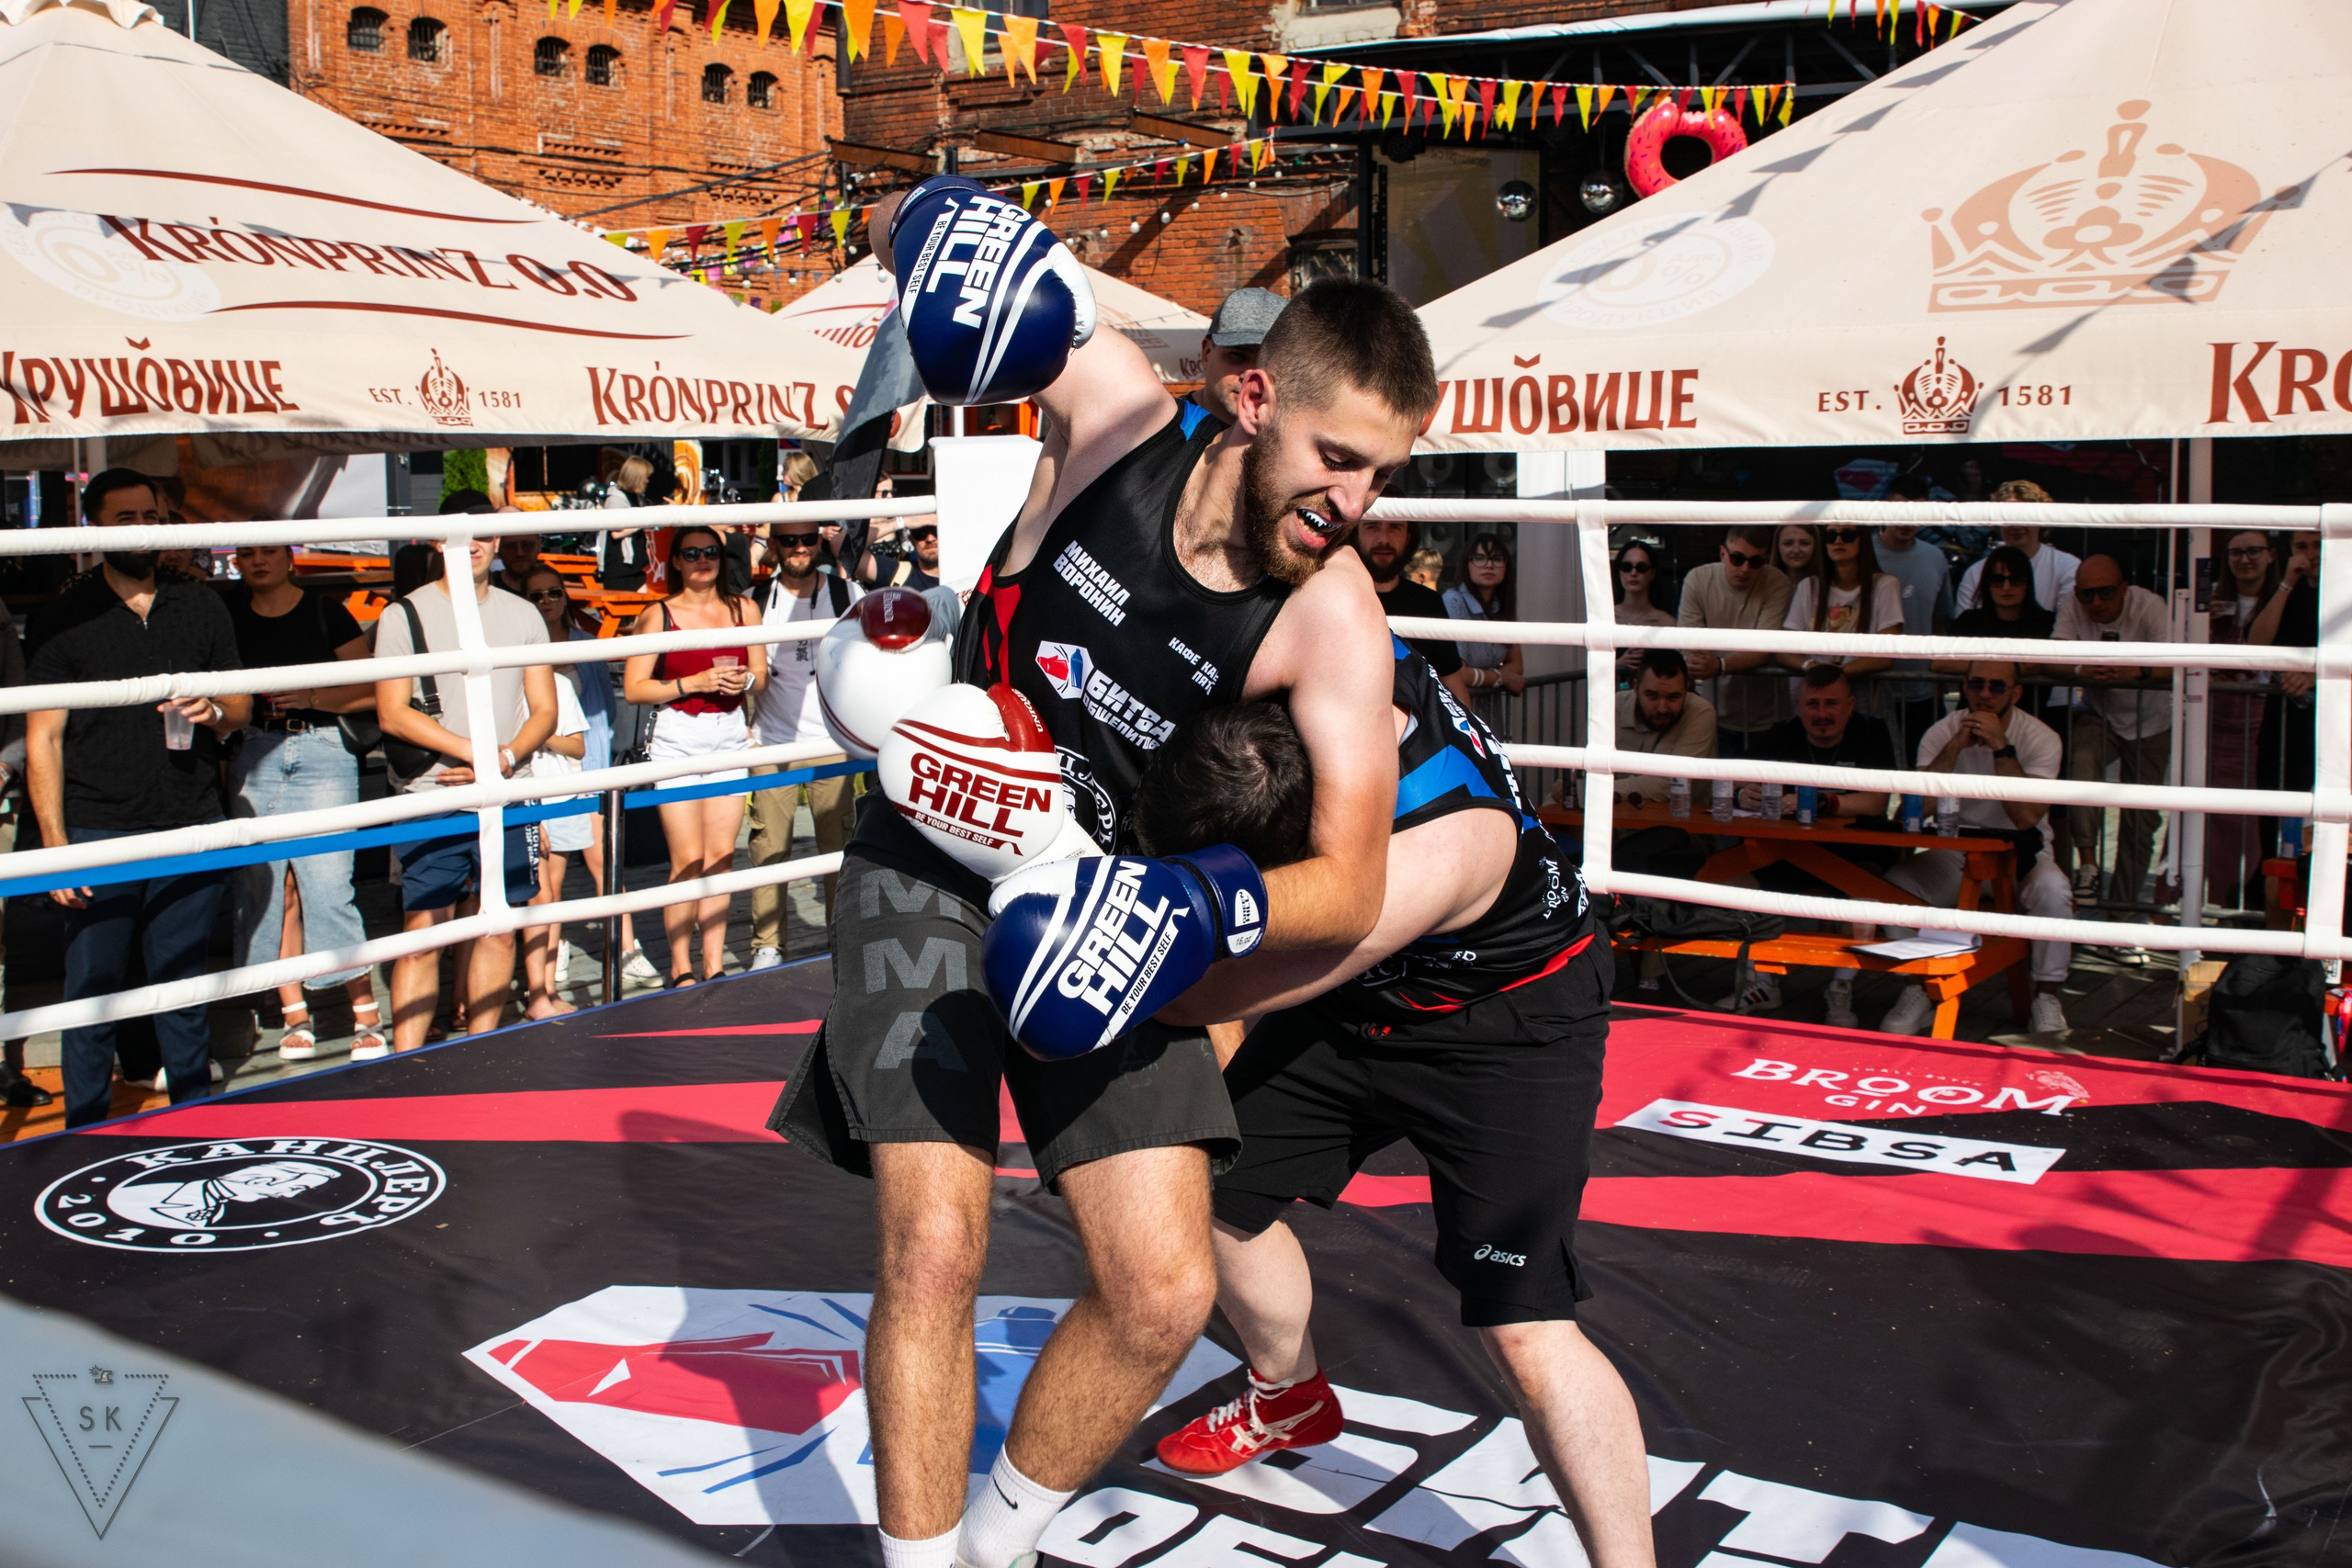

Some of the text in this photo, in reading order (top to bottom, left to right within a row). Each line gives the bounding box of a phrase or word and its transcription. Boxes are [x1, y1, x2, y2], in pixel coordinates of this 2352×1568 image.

[908, 220, 947, 294] BE YOUR BEST SELF
[925, 196, 1007, 293] HILL
[952, 204, 1032, 329] GREEN
[368, 387, 523, 409] EST. 1581
[1817, 384, 2072, 412] EST. 1581
[1053, 553, 1125, 626] ВОРОНИН
[1064, 540, 1130, 606] МИХАИЛ
[1169, 637, 1201, 665] КАФЕ
[1085, 670, 1176, 743] БИТВА
[908, 775, 1024, 838] HILL
[910, 752, 1051, 813] GREEN
[915, 811, 994, 847] BE YOUR BEST SELF
[1057, 861, 1148, 999] GREEN
[1080, 896, 1170, 1016] HILL
[859, 868, 969, 1071] MMA
[1121, 932, 1171, 1015] BE YOUR BEST SELF
[1730, 1057, 2079, 1117] BROOM
[1825, 1094, 1928, 1116] GIN
[1659, 1109, 2018, 1172] SIBSA
[124, 1139, 432, 1227] КАНЦЛЕРЪ
[56, 1193, 217, 1247] 2010
